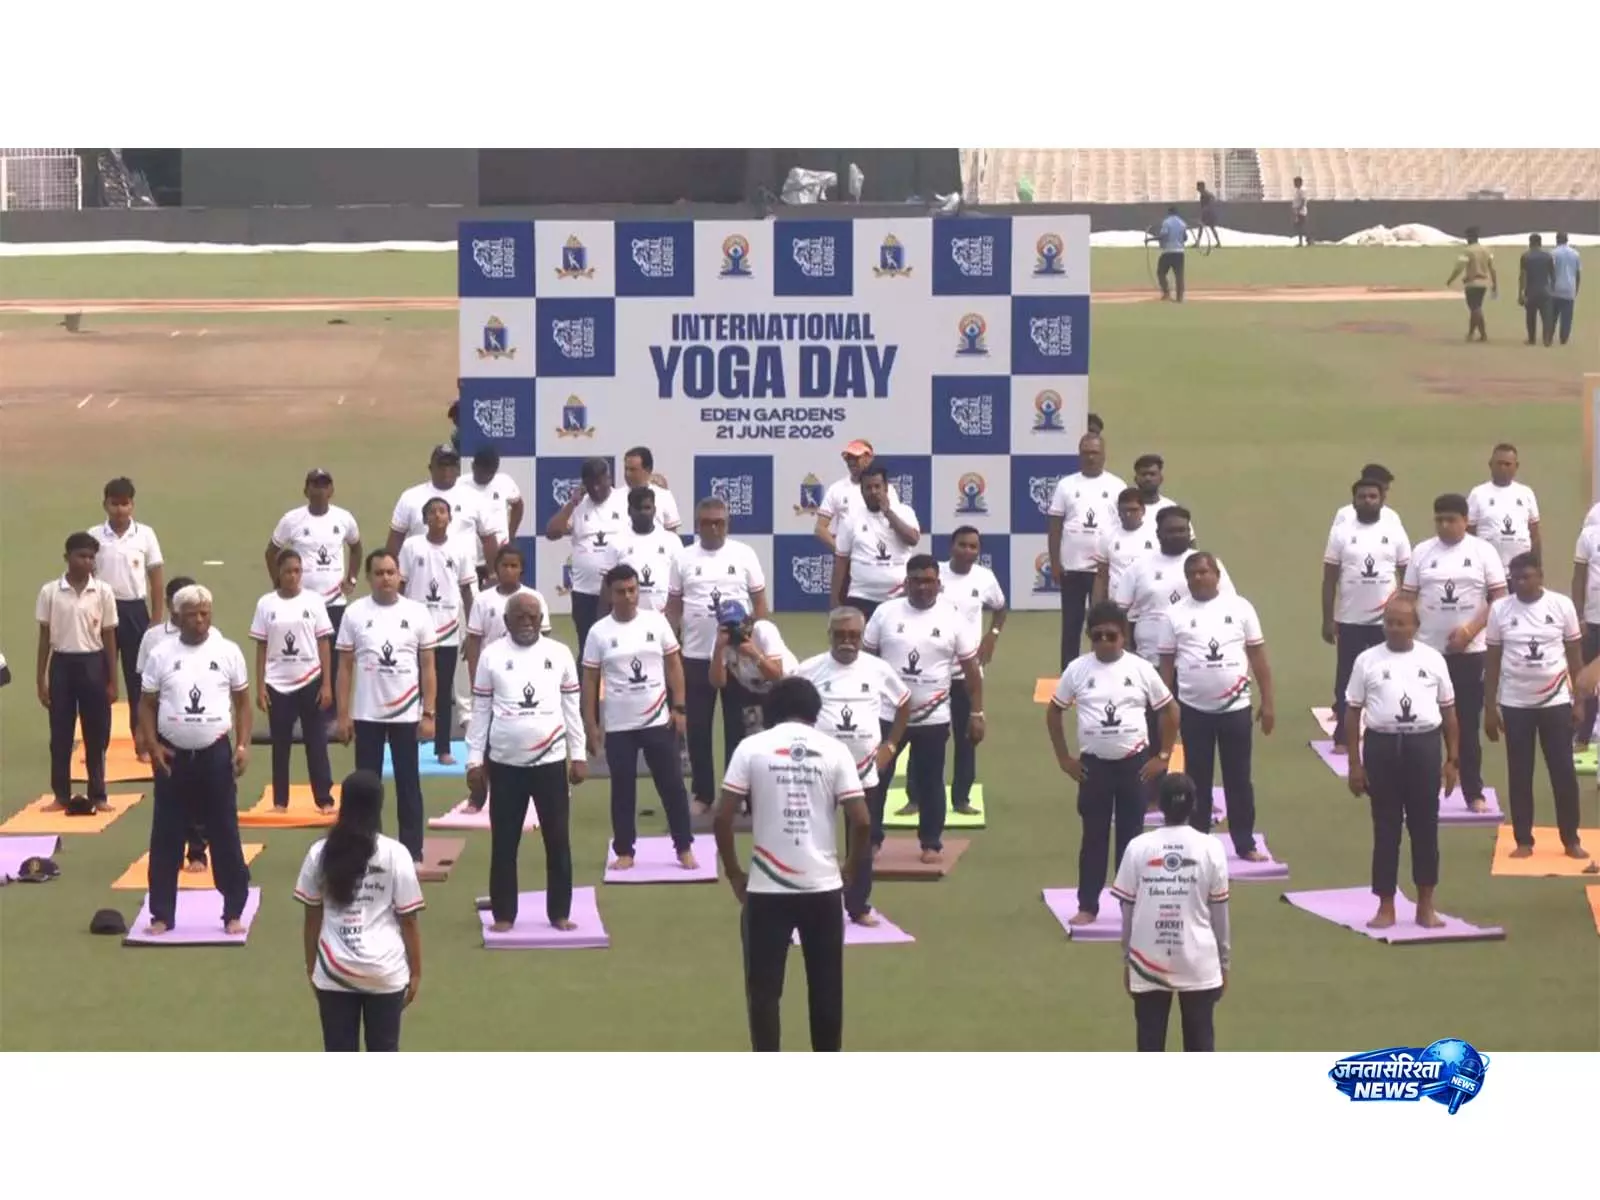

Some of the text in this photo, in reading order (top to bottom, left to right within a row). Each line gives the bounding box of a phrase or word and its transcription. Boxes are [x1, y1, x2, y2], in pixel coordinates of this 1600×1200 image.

[672, 313, 875, 341] INTERNATIONAL
[649, 345, 898, 399] YOGA DAY
[700, 407, 846, 422] EDEN GARDENS
[716, 425, 834, 439] 21 JUNE 2026
